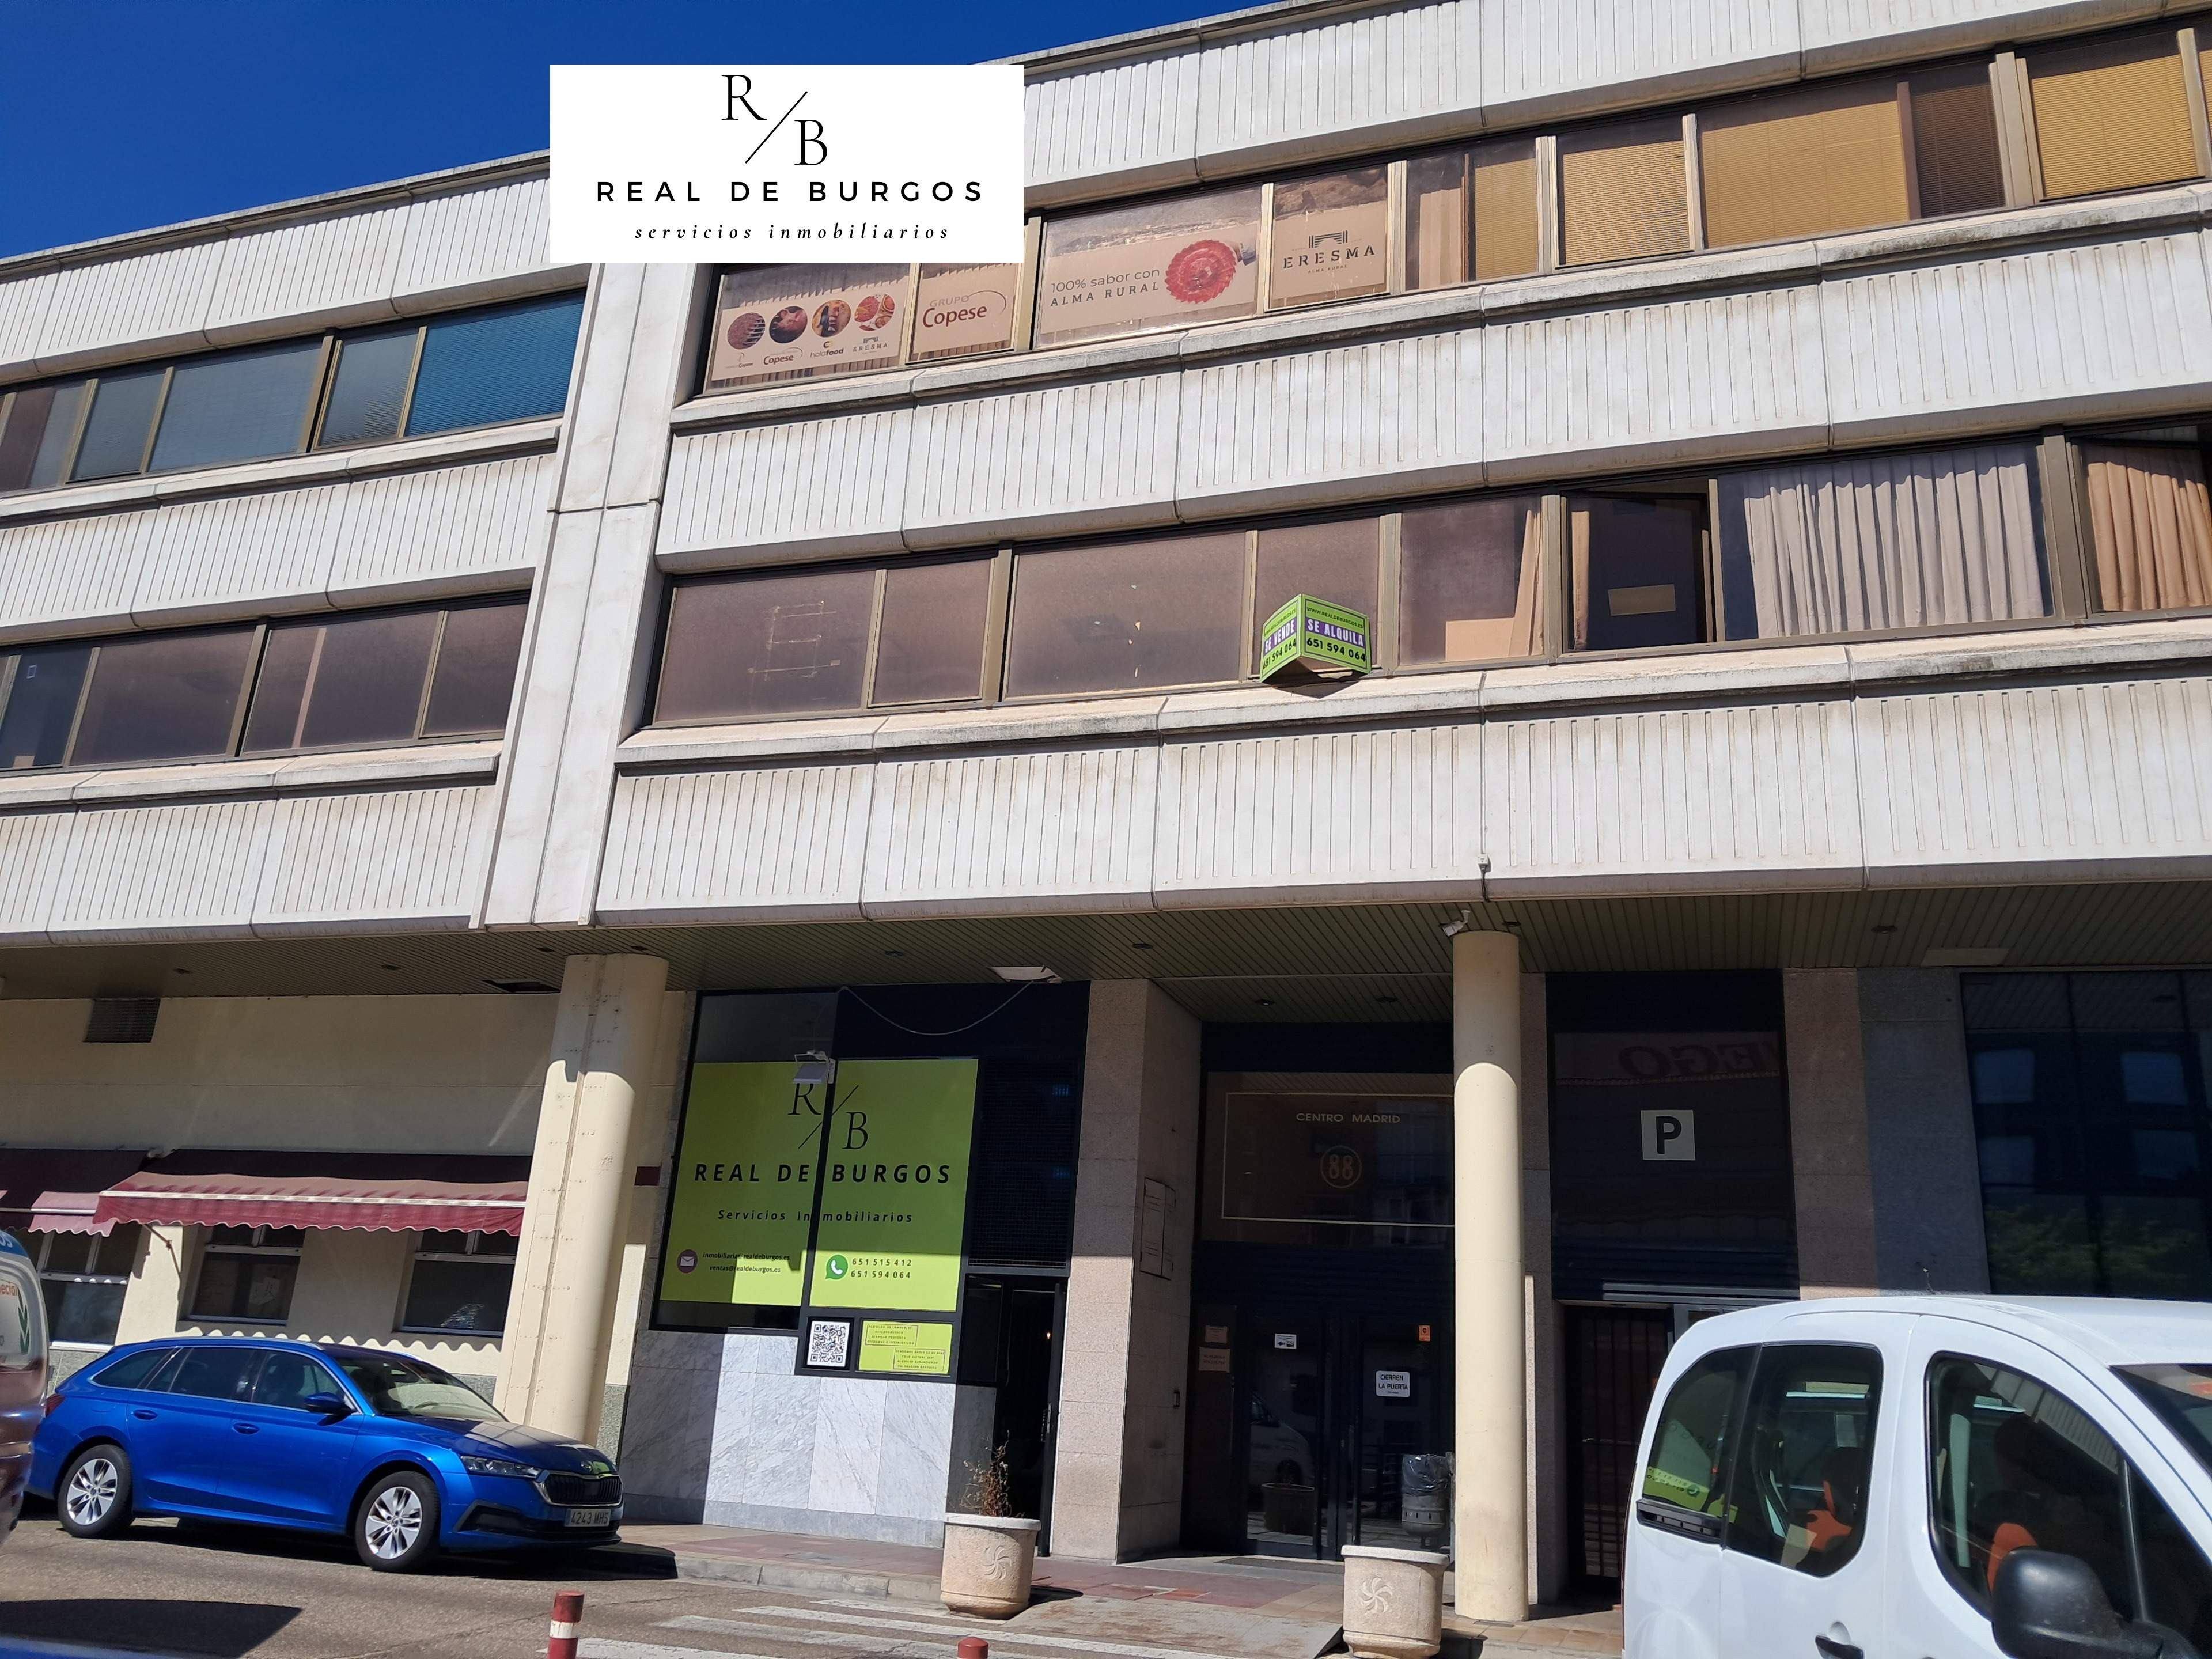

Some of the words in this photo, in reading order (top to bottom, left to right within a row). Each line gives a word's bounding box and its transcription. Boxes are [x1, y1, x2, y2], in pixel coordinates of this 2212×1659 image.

[1283, 245, 1376, 269] ERESMA
[1051, 278, 1086, 294] 100%
[1090, 272, 1130, 288] sabor
[1134, 268, 1160, 280] con
[929, 295, 970, 308] GRUPO
[1050, 291, 1095, 307] ALMA
[1105, 282, 1158, 299] RURAL
[923, 306, 987, 328] Copese
[853, 343, 888, 353] ERESMA
[763, 355, 794, 365] Copese
[1265, 636, 1272, 653] SE
[1274, 619, 1296, 646] VENDE
[1308, 619, 1320, 632] SE
[1324, 624, 1364, 646] ALQUILA
[1272, 647, 1283, 662] 594
[1285, 638, 1297, 653] 064
[1306, 638, 1323, 649] 651
[1327, 642, 1345, 655] 594
[1349, 649, 1366, 662] 064
[1296, 1112, 1344, 1123] CENTRO
[1351, 1113, 1402, 1124] MADRID
[1655, 1115, 1682, 1155] P
[694, 1164, 760, 1183] REAL
[777, 1164, 810, 1183] DE
[832, 1164, 951, 1184] BURGOS
[1328, 1154, 1354, 1180] 88
[718, 1209, 786, 1221] Servicios
[851, 1270, 868, 1278] 651
[571, 1512, 592, 1525] 4243
